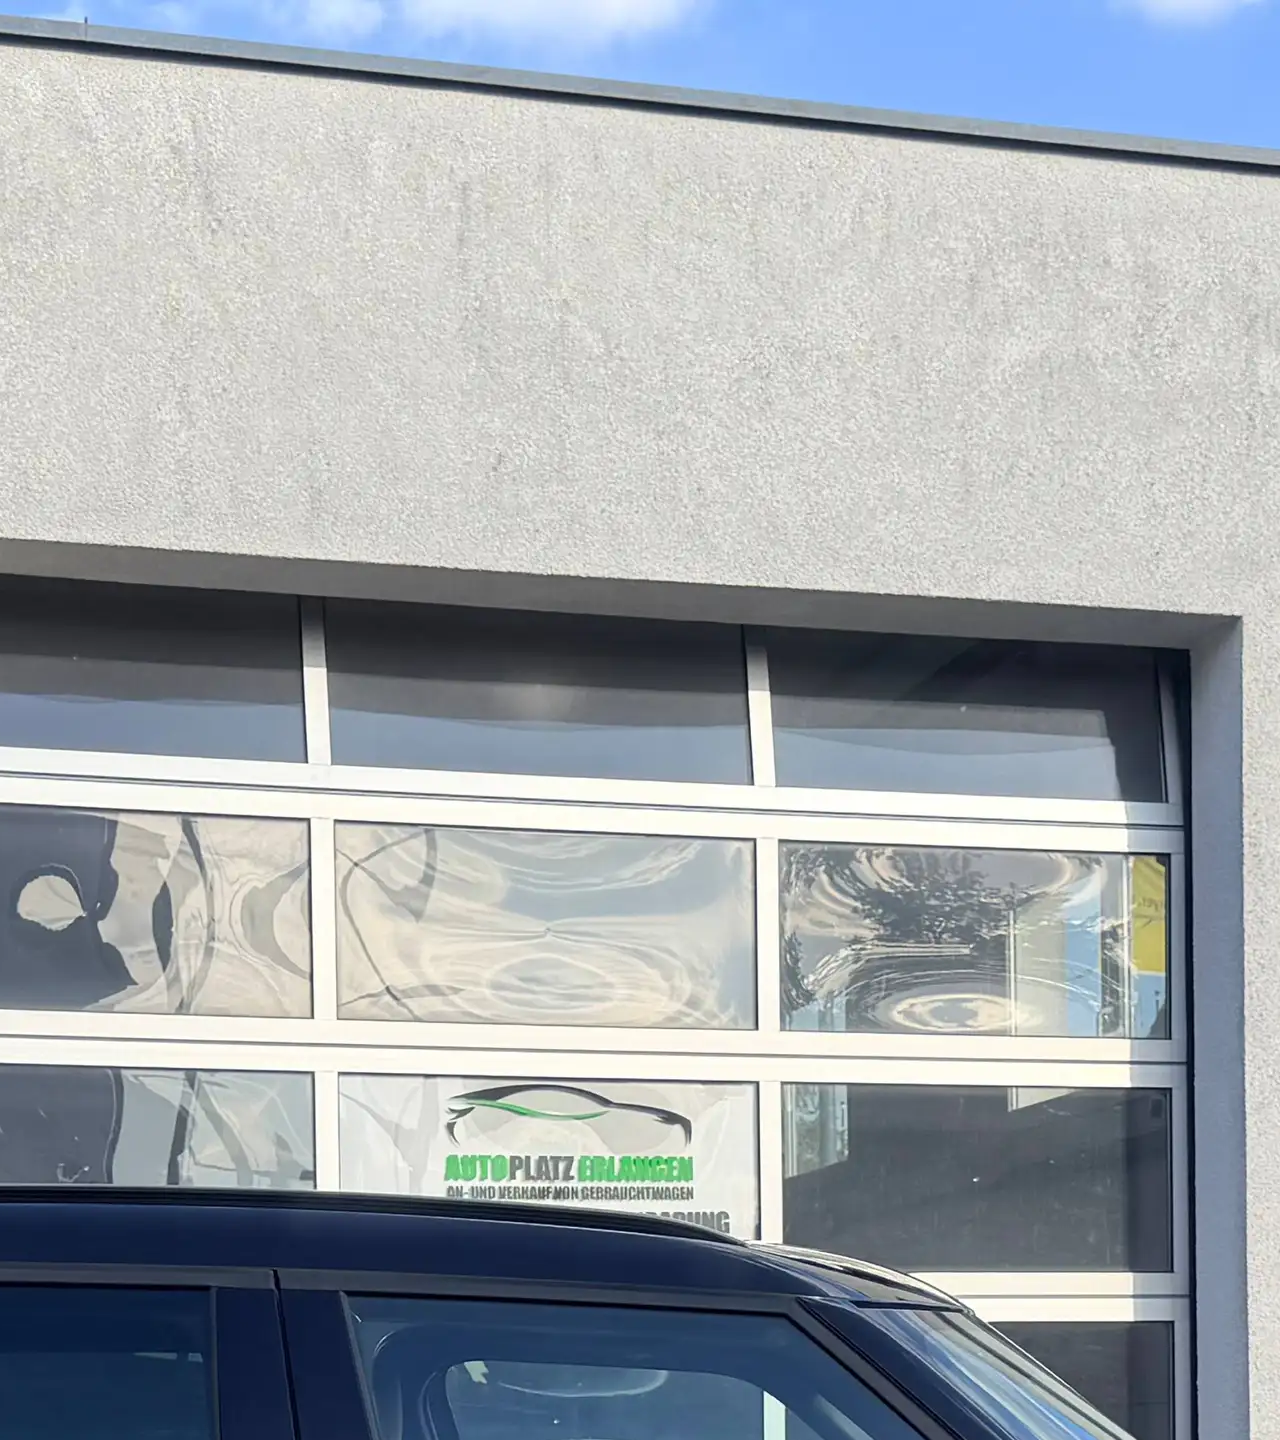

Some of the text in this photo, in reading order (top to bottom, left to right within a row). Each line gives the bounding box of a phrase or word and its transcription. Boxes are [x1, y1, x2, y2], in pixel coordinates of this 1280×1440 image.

[444, 1154, 694, 1182] AUTOPLATZ ERLANGEN
[446, 1186, 694, 1200] AN- UND VERKAUF VON GEBRAUCHTWAGEN
